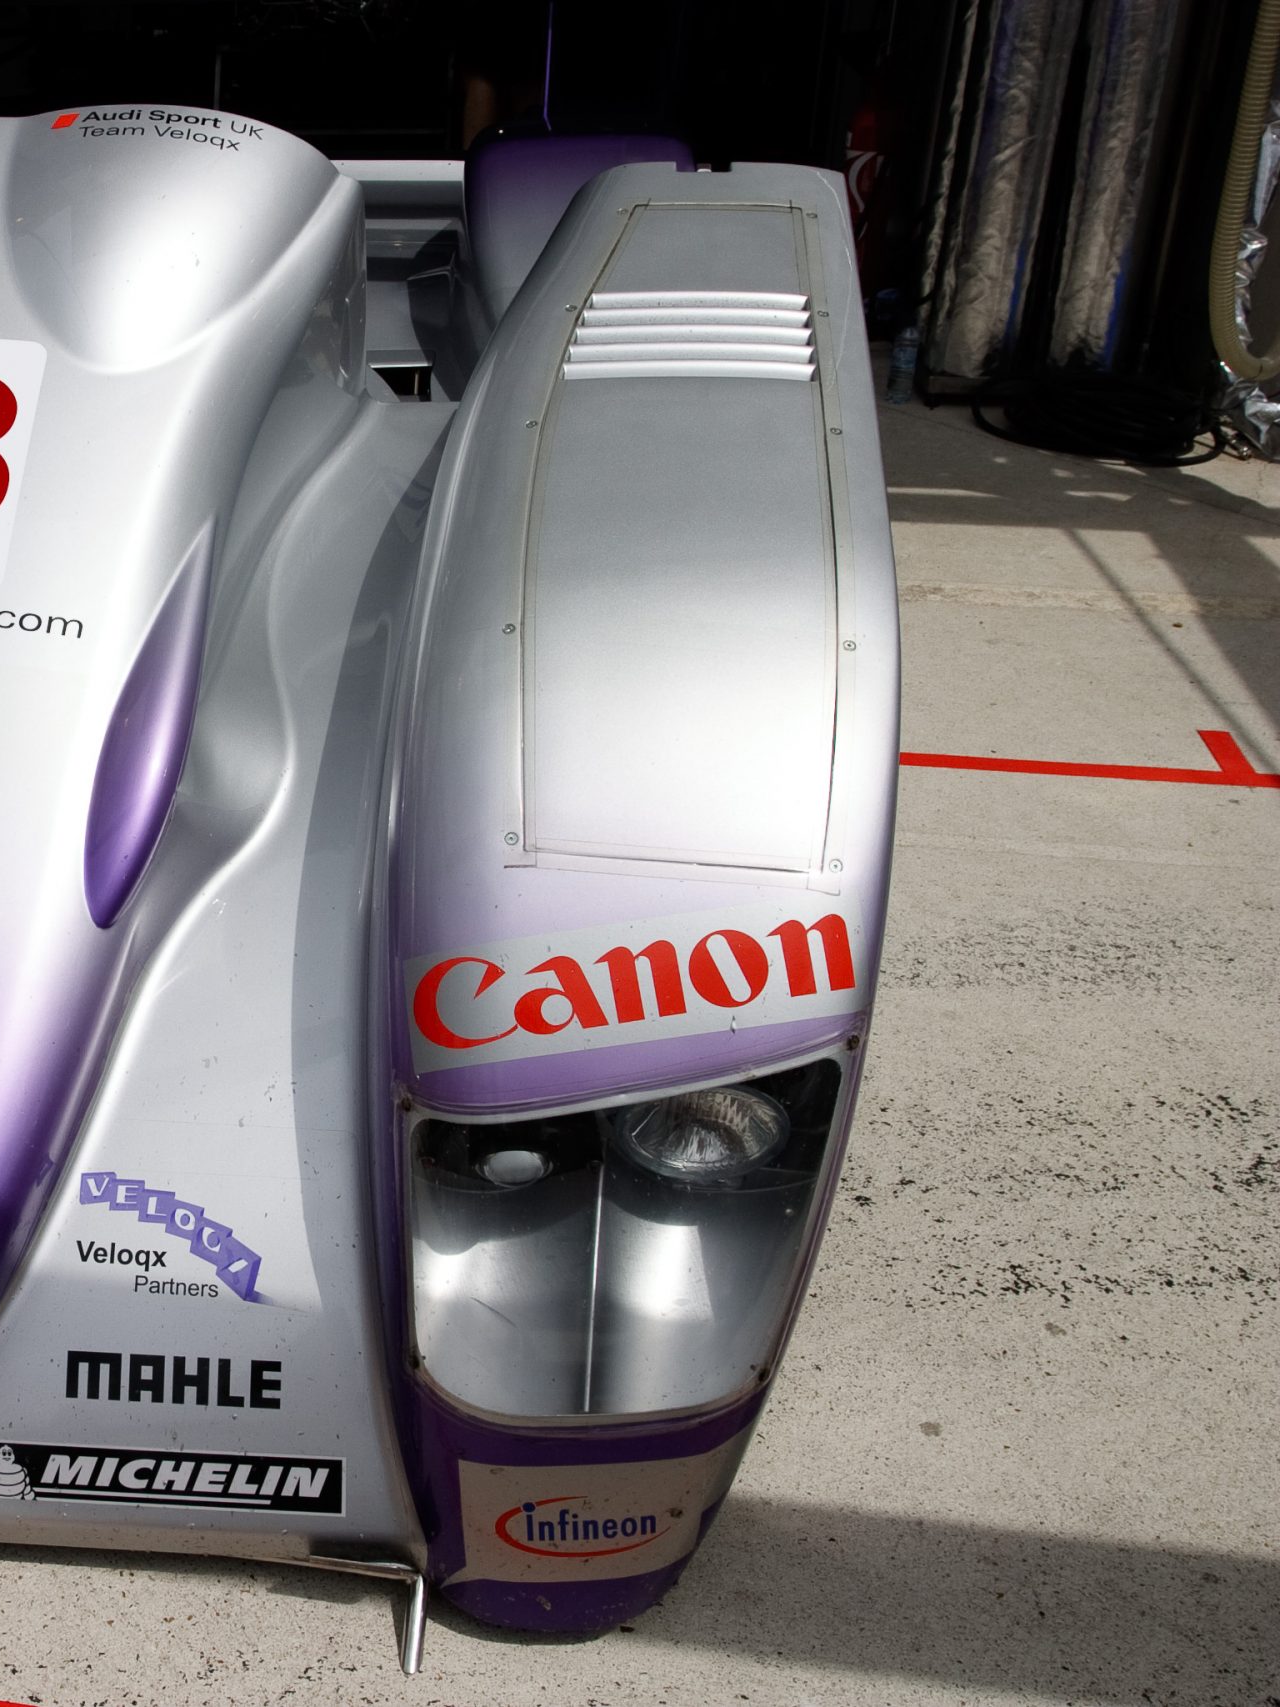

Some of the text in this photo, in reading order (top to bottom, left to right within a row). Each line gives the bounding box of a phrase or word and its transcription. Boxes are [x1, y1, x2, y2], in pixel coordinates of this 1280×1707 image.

[79, 125, 240, 151] Team Veloqx
[82, 109, 264, 140] Audi Sport UK
[413, 913, 856, 1049] Canon
[76, 1240, 167, 1272] Veloqx
[134, 1275, 219, 1297] Partners
[65, 1350, 282, 1410] MAHLE
[40, 1453, 330, 1499] MICHELIN
